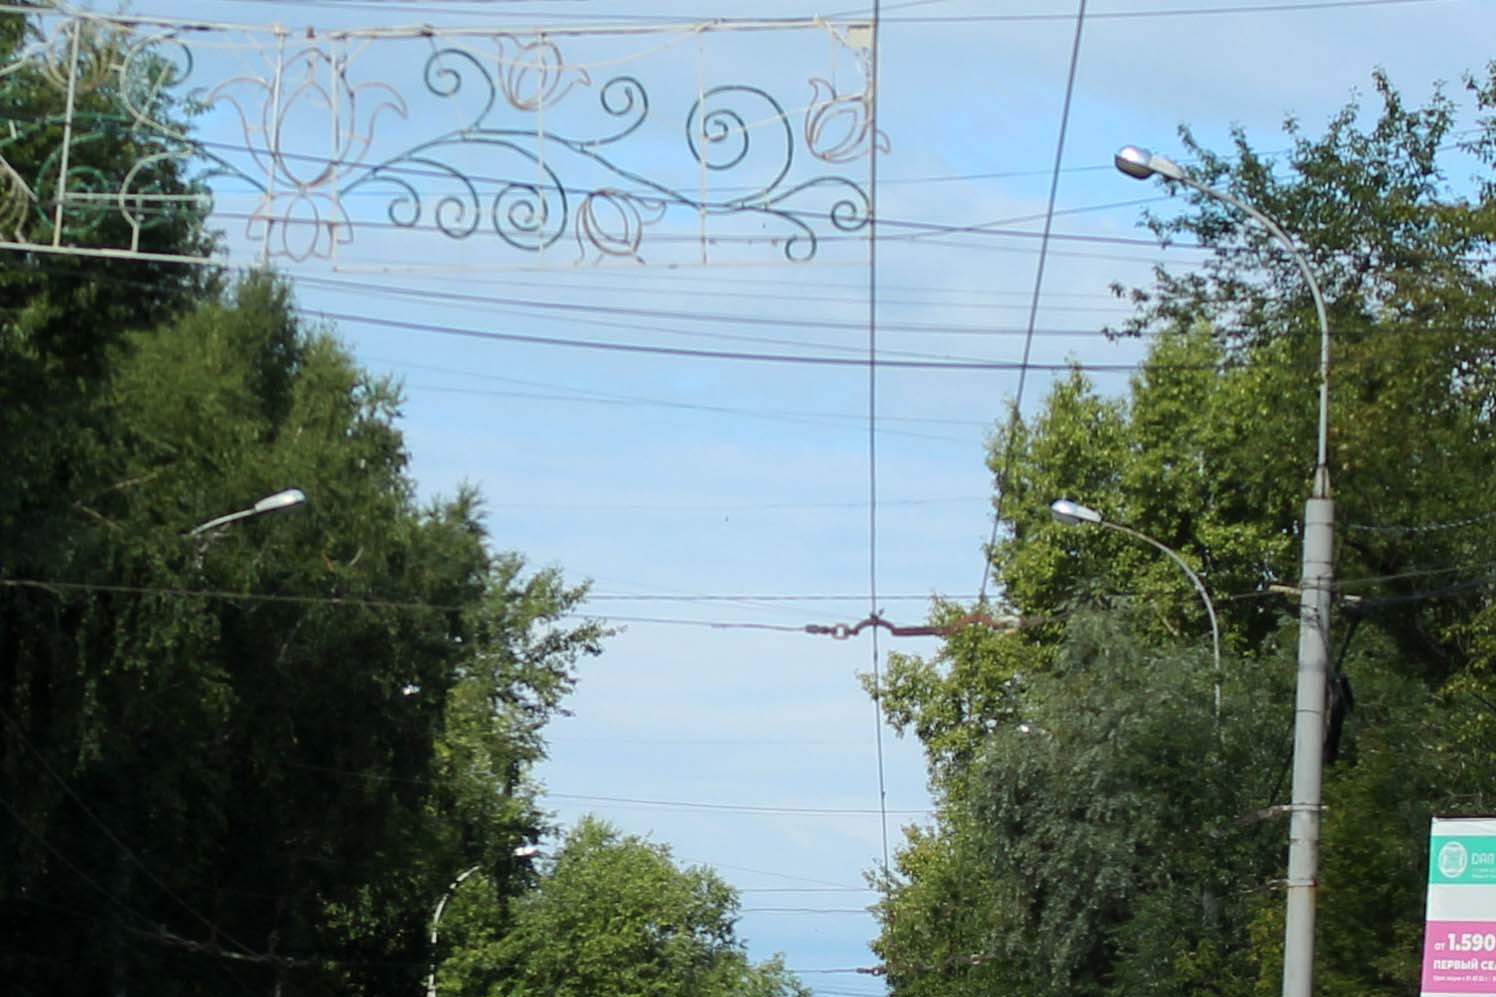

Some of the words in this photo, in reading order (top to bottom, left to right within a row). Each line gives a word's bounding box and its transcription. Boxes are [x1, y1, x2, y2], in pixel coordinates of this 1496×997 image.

[1434, 942, 1446, 950] от
[1447, 933, 1496, 951] 1.590
[1433, 958, 1478, 970] ПЕРВЫЙ
